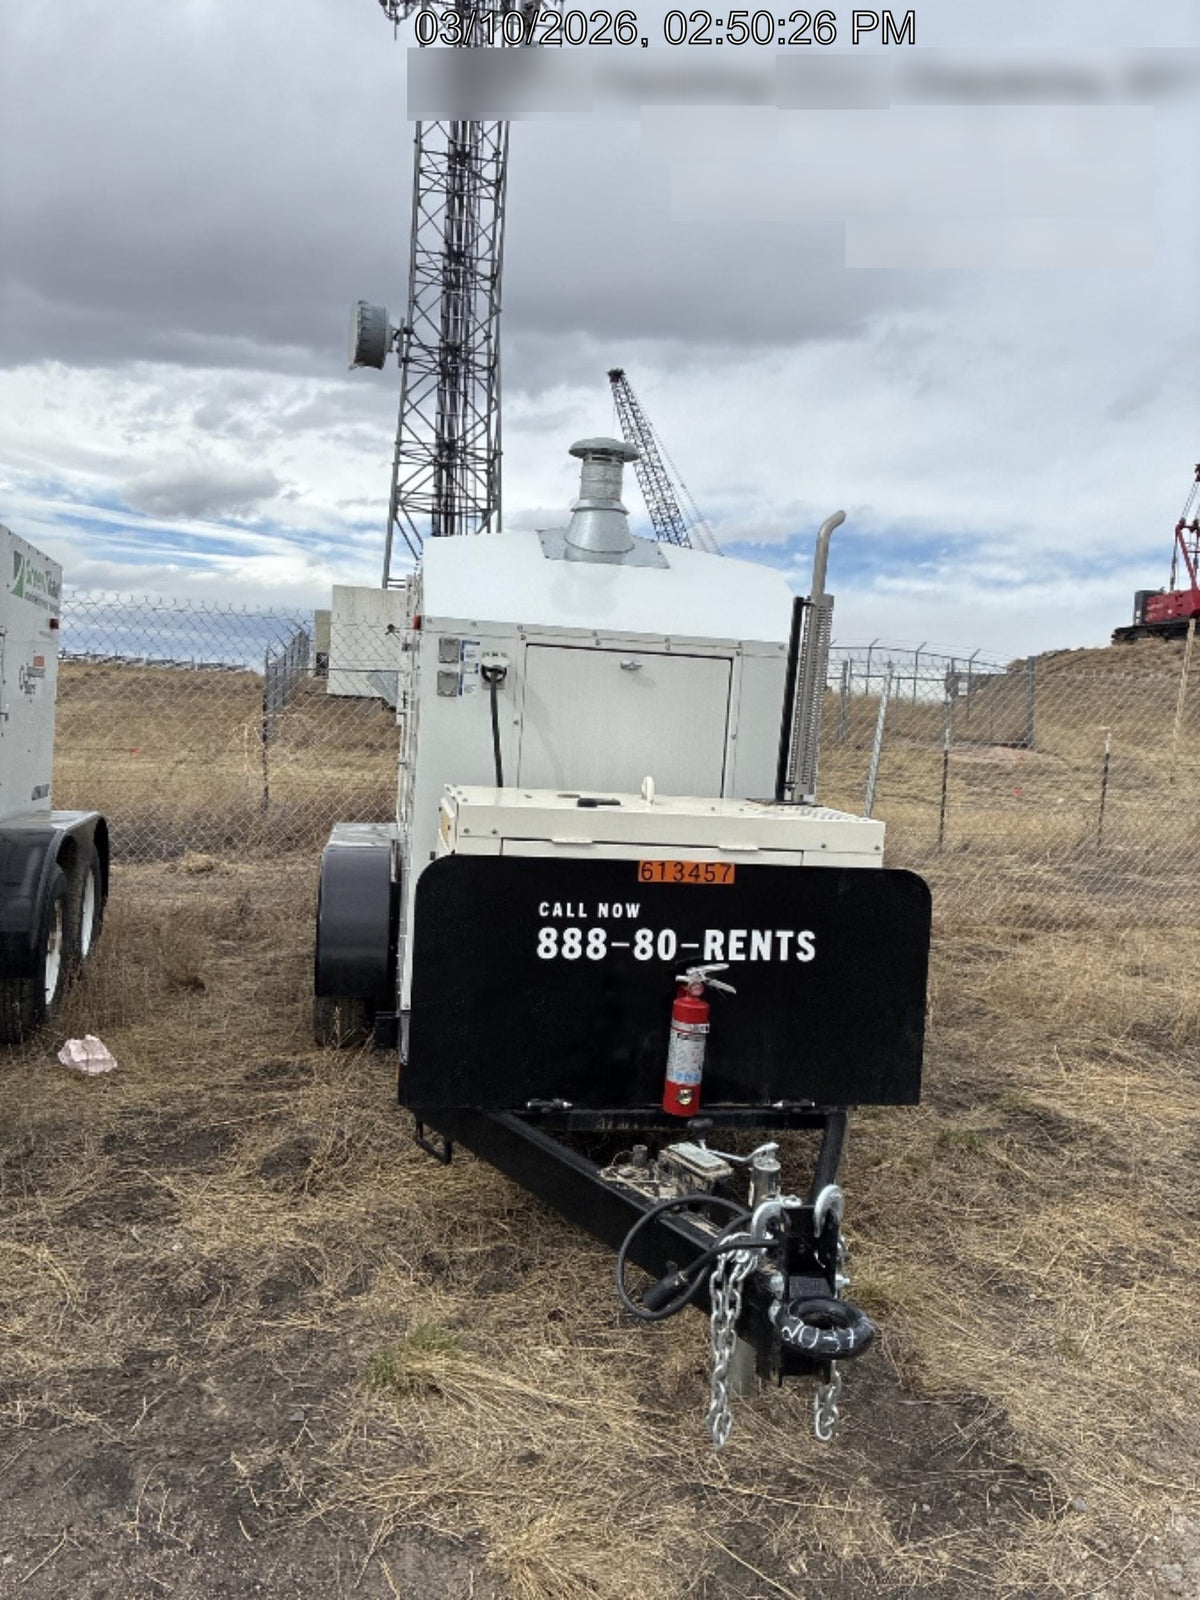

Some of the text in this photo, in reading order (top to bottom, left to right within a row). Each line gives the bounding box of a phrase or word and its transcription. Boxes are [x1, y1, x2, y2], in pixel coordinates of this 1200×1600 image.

[641, 861, 732, 883] 613457
[538, 901, 641, 919] CALL NOW
[536, 926, 816, 963] 888-80-RENTS
